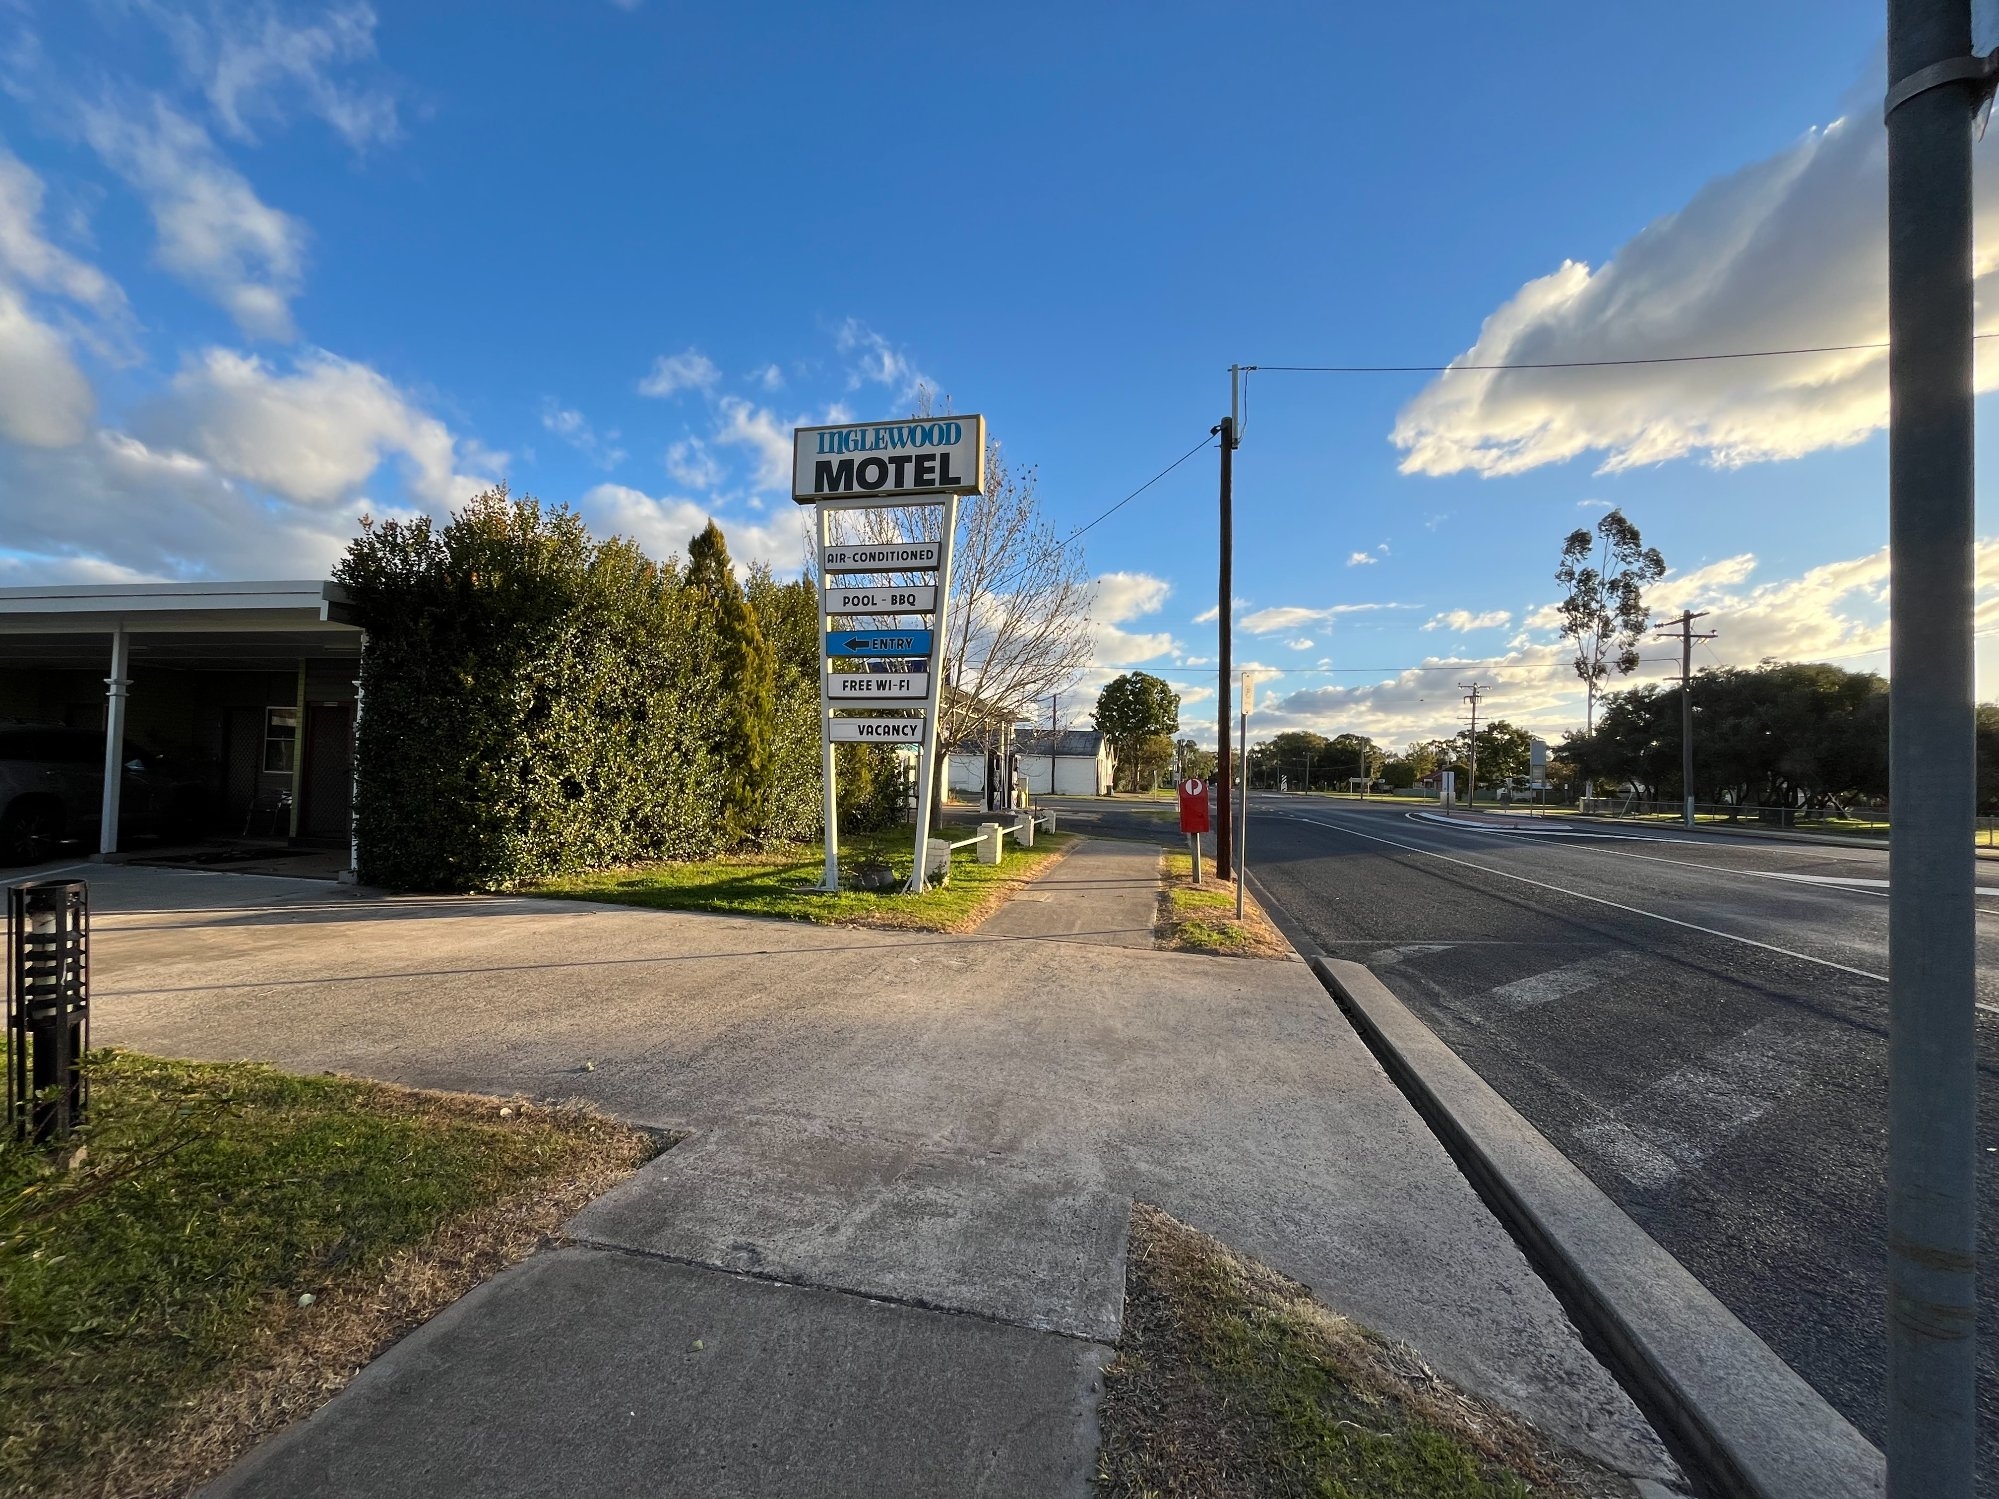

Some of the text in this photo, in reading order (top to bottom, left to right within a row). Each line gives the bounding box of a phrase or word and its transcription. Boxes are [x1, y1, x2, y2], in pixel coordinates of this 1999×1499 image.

[816, 422, 962, 454] INGLEWOOD
[815, 453, 962, 492] MOTEL
[827, 549, 934, 563] AIR-CONDITIONED
[843, 595, 877, 607] POOL
[891, 594, 916, 606] BBQ
[872, 637, 914, 650] ENTRY
[842, 679, 910, 691] FREE WI-FI
[857, 724, 918, 736] VACANCY
